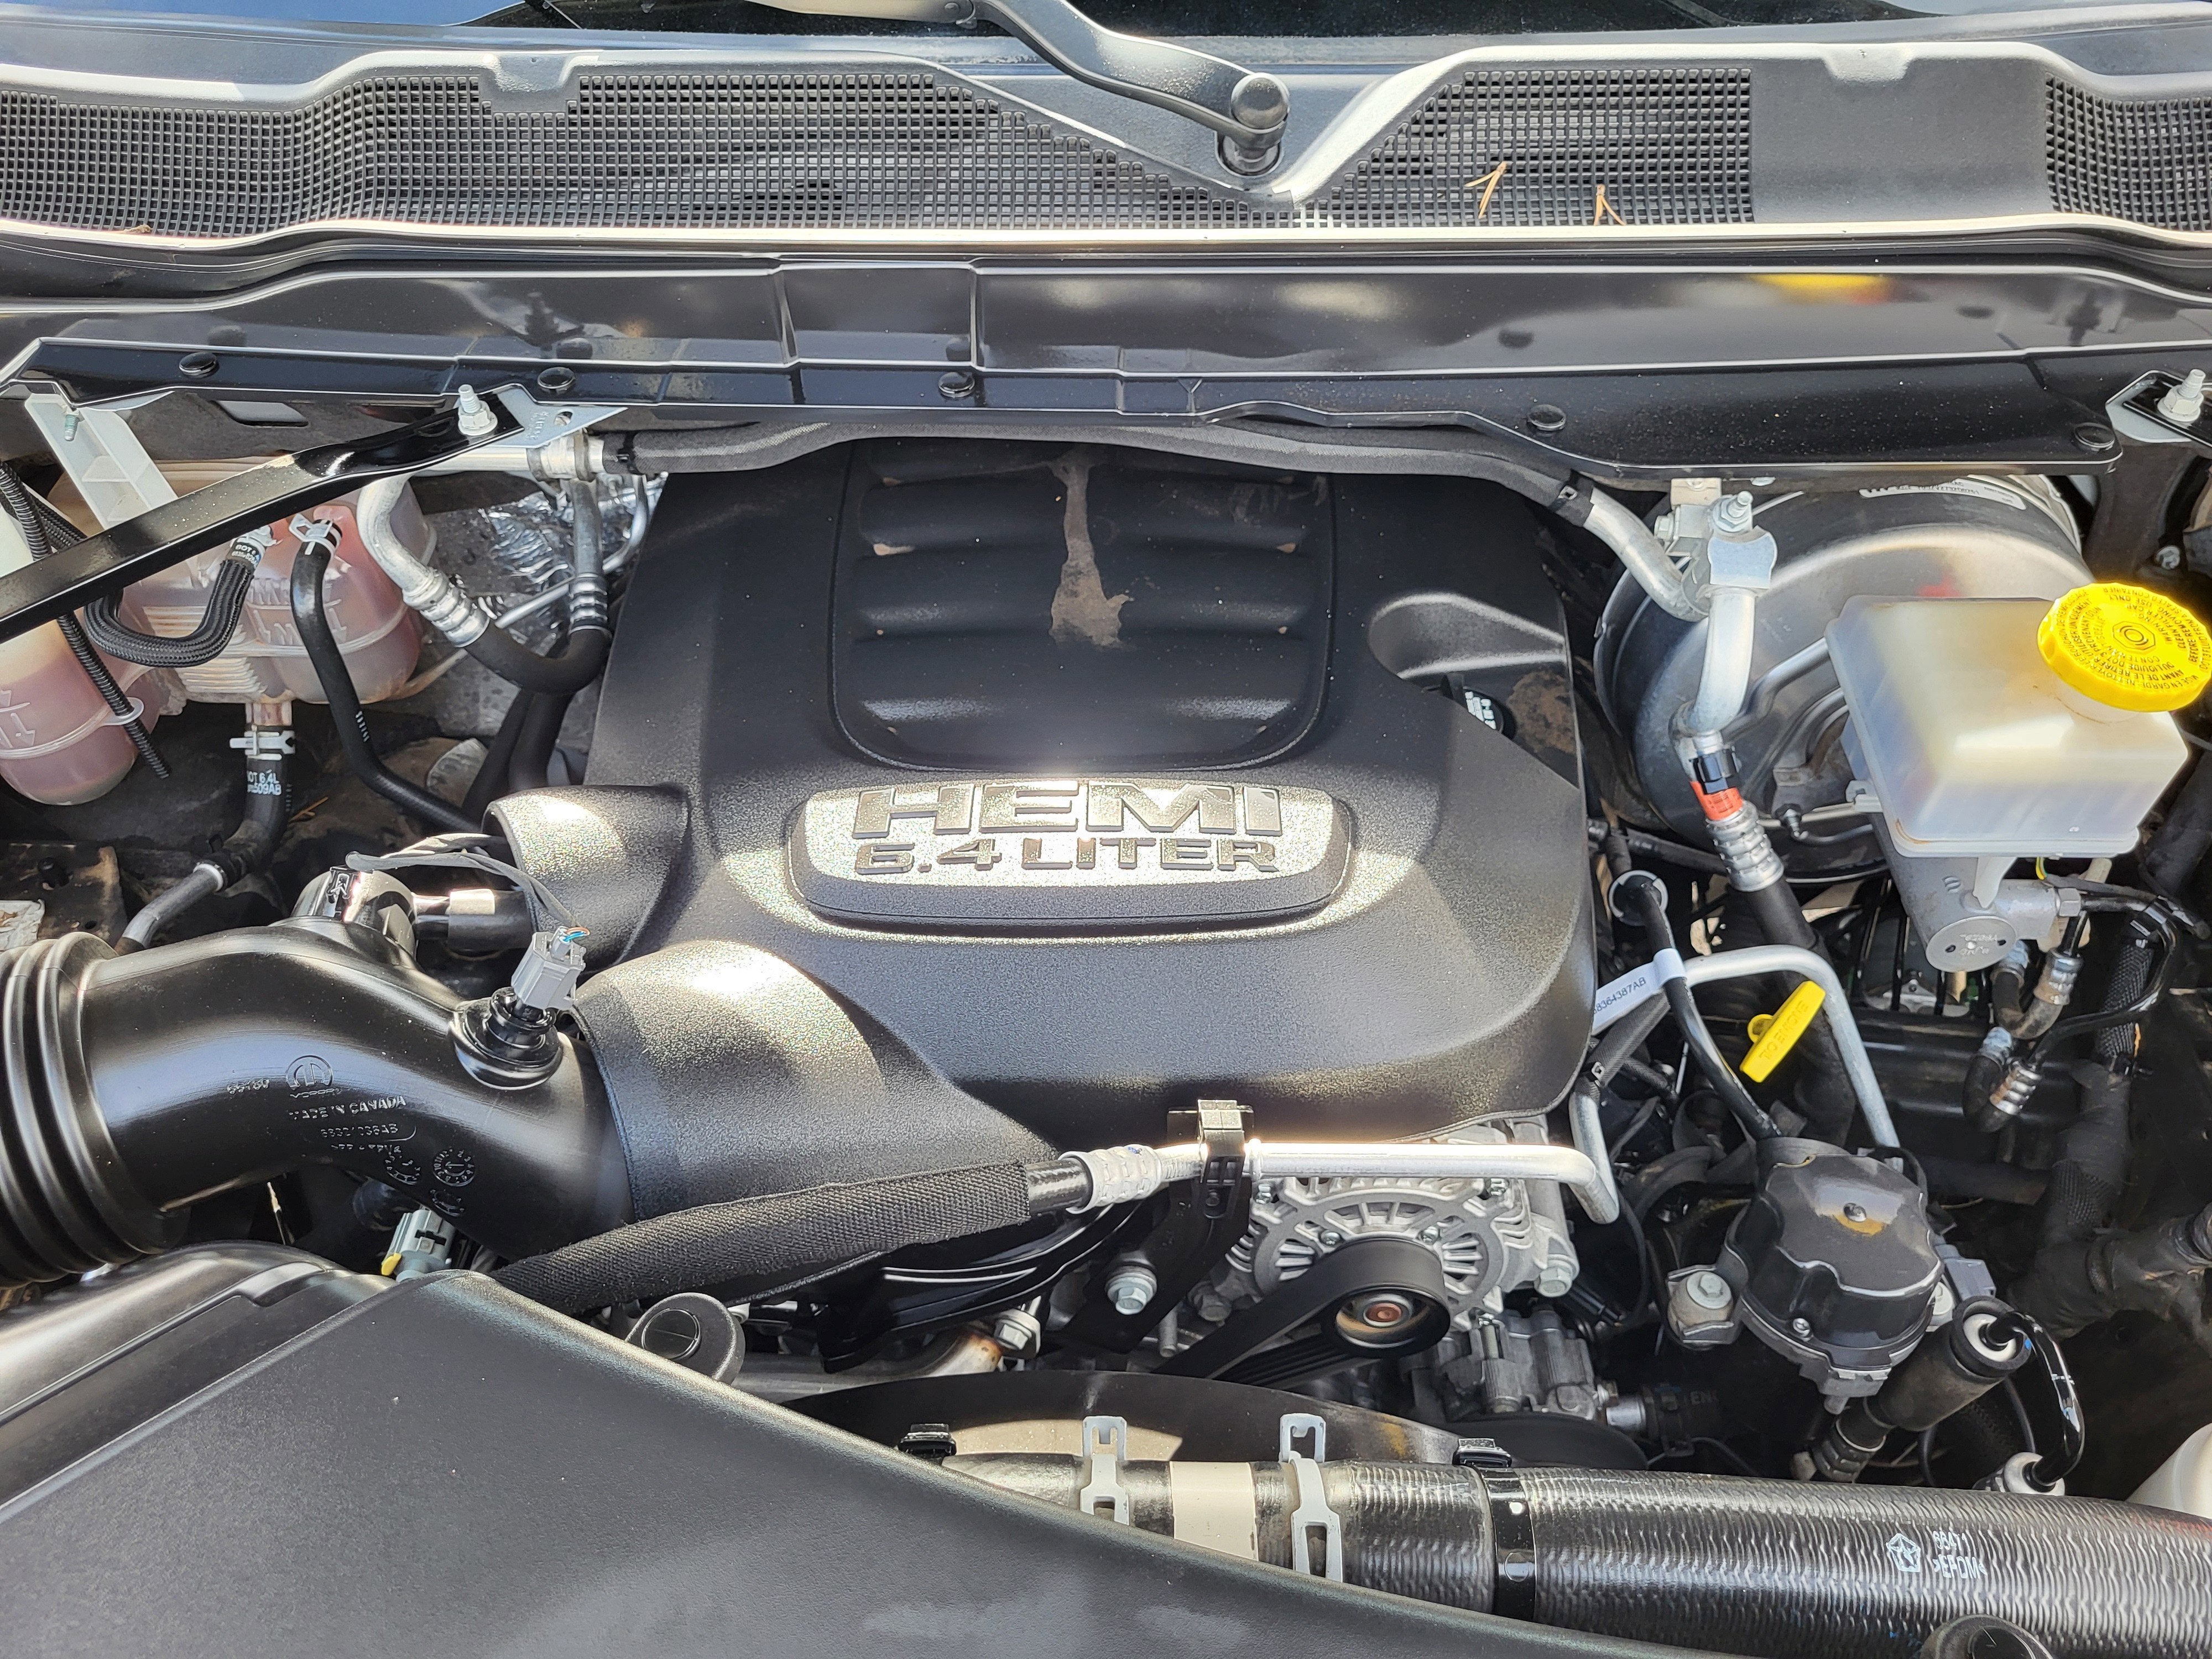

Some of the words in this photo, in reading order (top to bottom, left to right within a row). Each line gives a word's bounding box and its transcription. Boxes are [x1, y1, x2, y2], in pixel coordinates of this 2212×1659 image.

[2093, 657, 2129, 676] RETIRER
[2106, 656, 2124, 666] DOT
[2161, 661, 2174, 670] DU
[2159, 670, 2184, 680] AVANT
[852, 780, 1282, 838] HEMI
[853, 837, 1001, 875] 6.4
[1021, 837, 1280, 874] LITER
[349, 1095, 406, 1114] CANADA
